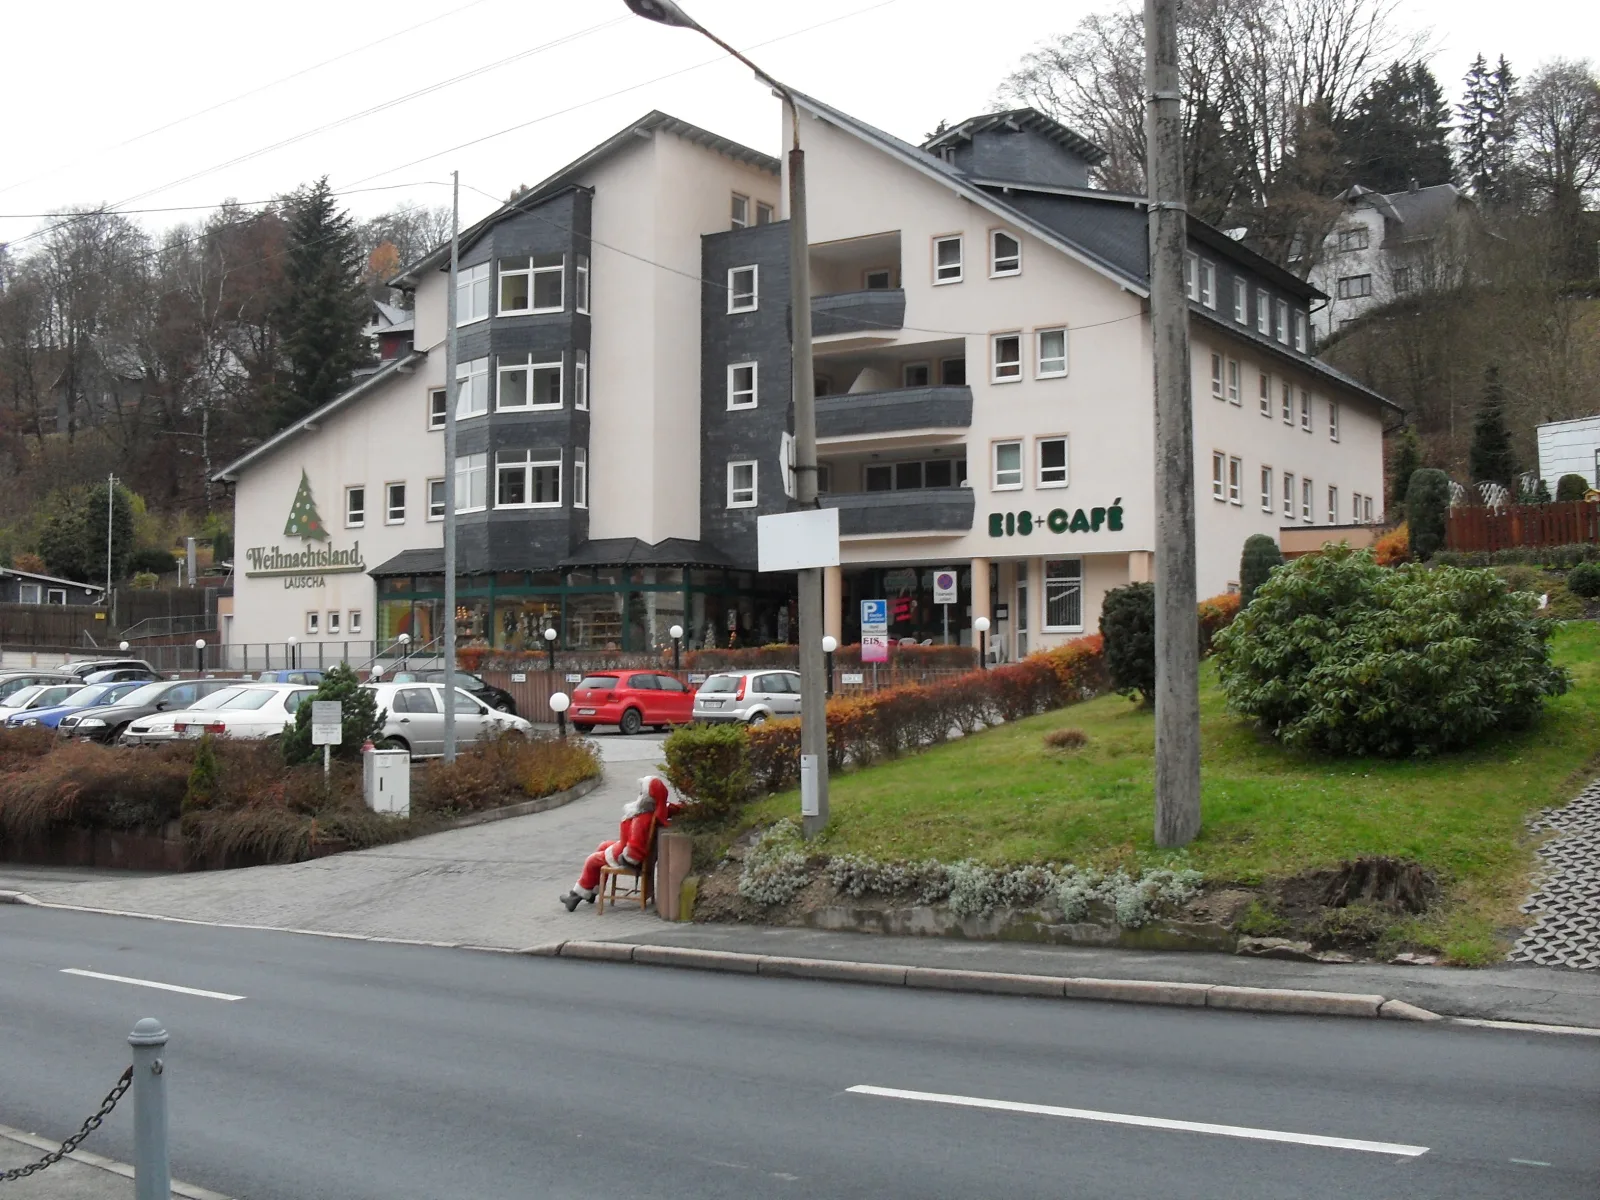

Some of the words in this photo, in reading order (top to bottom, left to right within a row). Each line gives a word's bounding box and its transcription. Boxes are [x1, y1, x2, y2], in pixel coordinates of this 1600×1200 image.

[246, 540, 364, 570] Weihnachtsland
[284, 576, 326, 589] LAUSCHA
[863, 602, 877, 622] P
[863, 637, 880, 645] EIS
